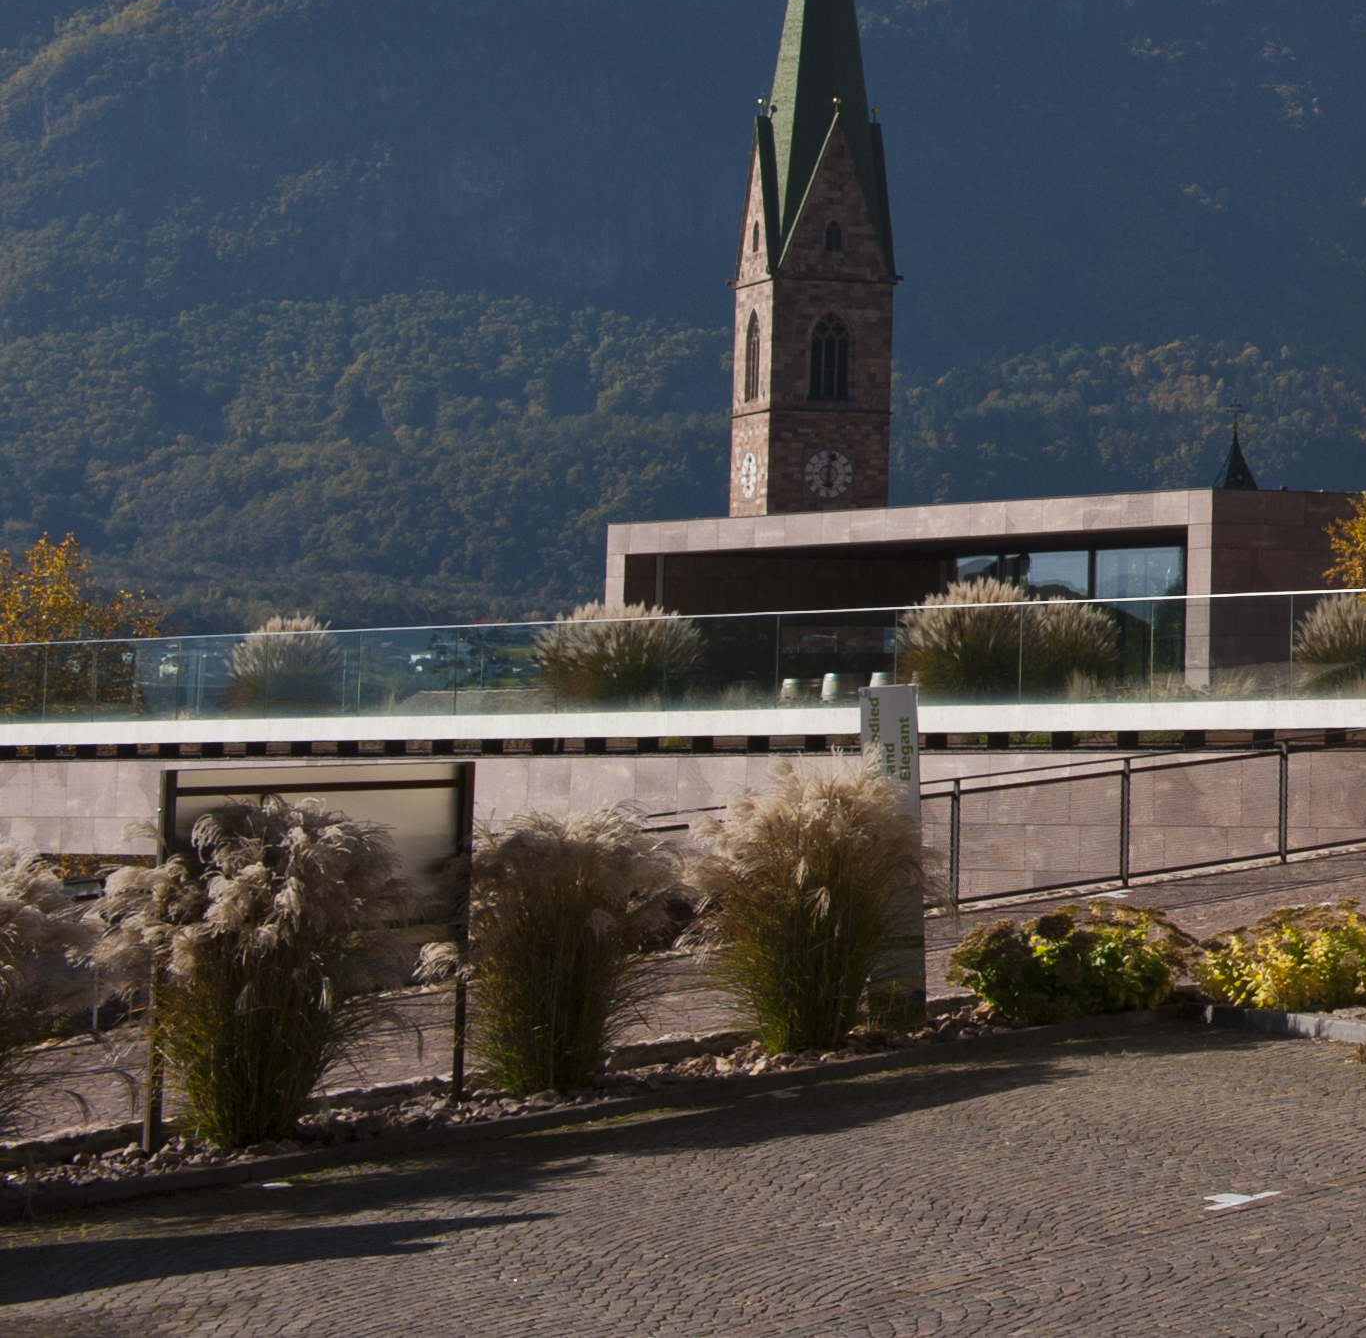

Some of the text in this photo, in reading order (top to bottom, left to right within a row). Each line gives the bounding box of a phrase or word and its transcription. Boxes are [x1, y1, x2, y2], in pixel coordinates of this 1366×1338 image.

[868, 697, 880, 748] odied
[883, 743, 896, 775] and
[899, 716, 914, 781] Elegant
